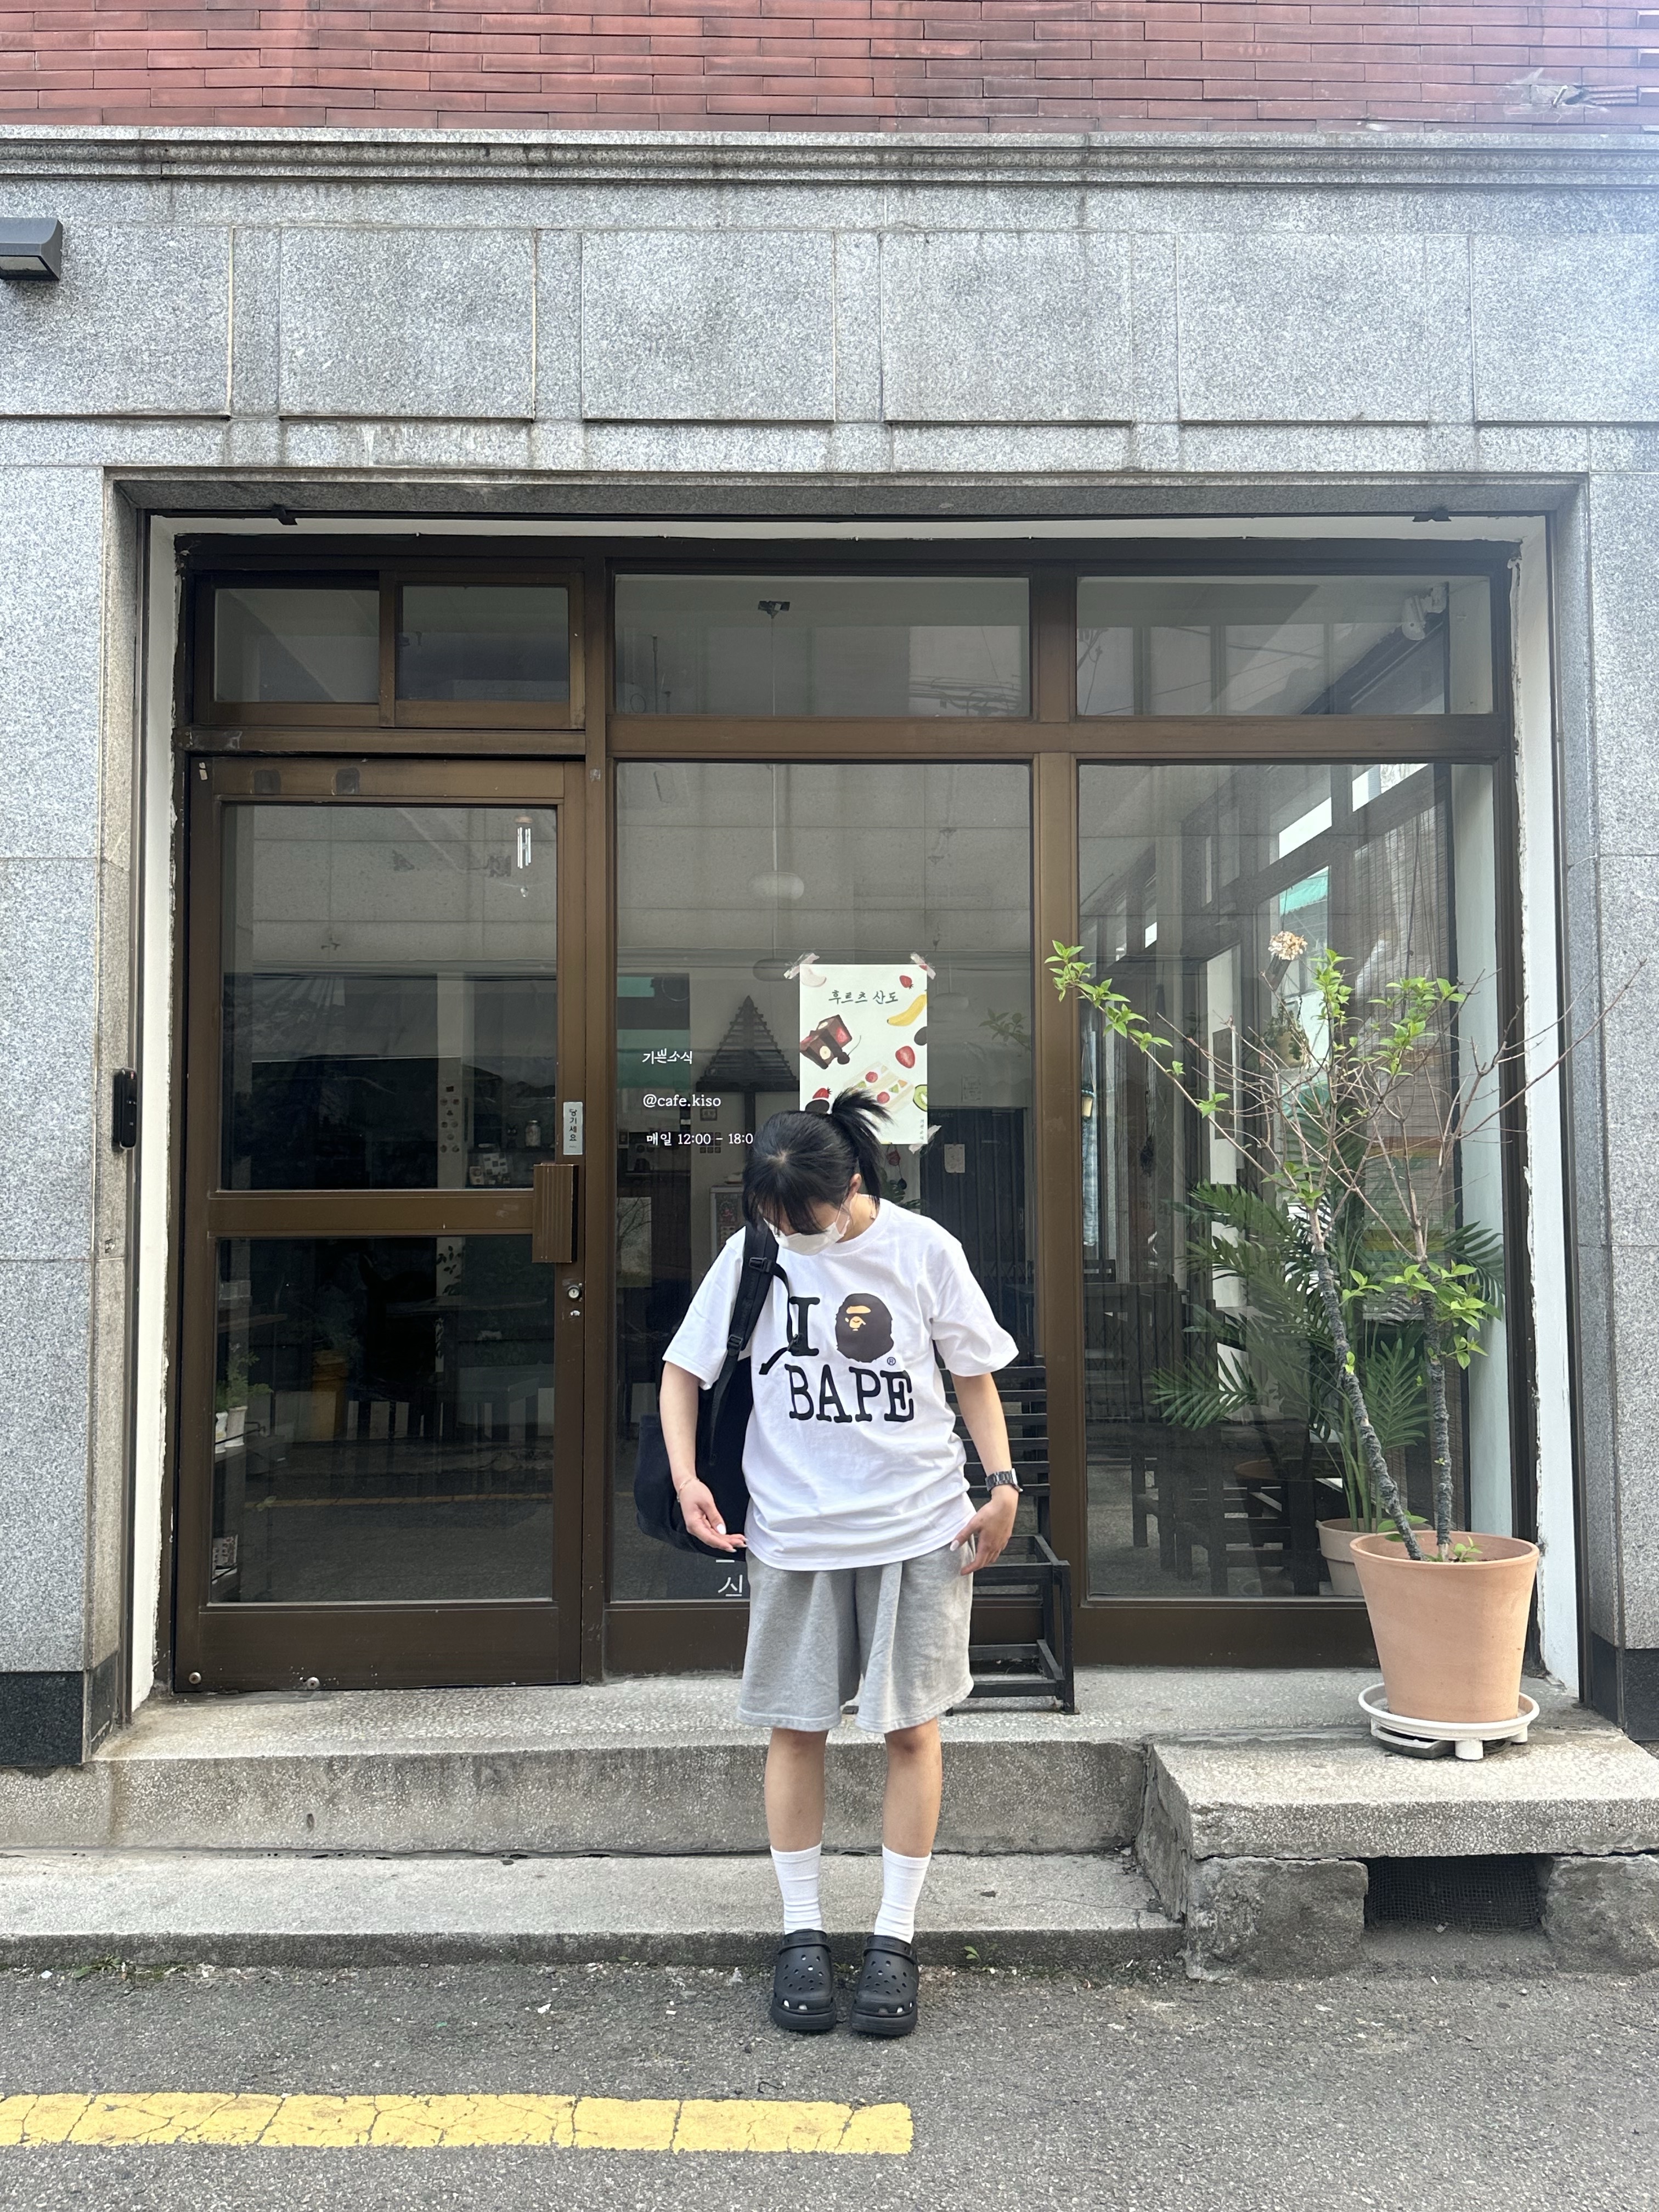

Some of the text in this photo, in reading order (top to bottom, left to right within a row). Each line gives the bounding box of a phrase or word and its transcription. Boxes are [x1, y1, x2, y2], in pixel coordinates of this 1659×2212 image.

[828, 989, 898, 1005] 후르츠 산도
[642, 1047, 693, 1065] 기쁜소식
[643, 1093, 721, 1108] @cafe.kiso
[569, 1109, 578, 1142] 당기세요
[646, 1131, 672, 1146] 매일
[678, 1133, 711, 1145] 12:00
[728, 1132, 754, 1145] 18:0
[788, 1296, 821, 1357] I
[784, 1363, 915, 1424] BAPE
